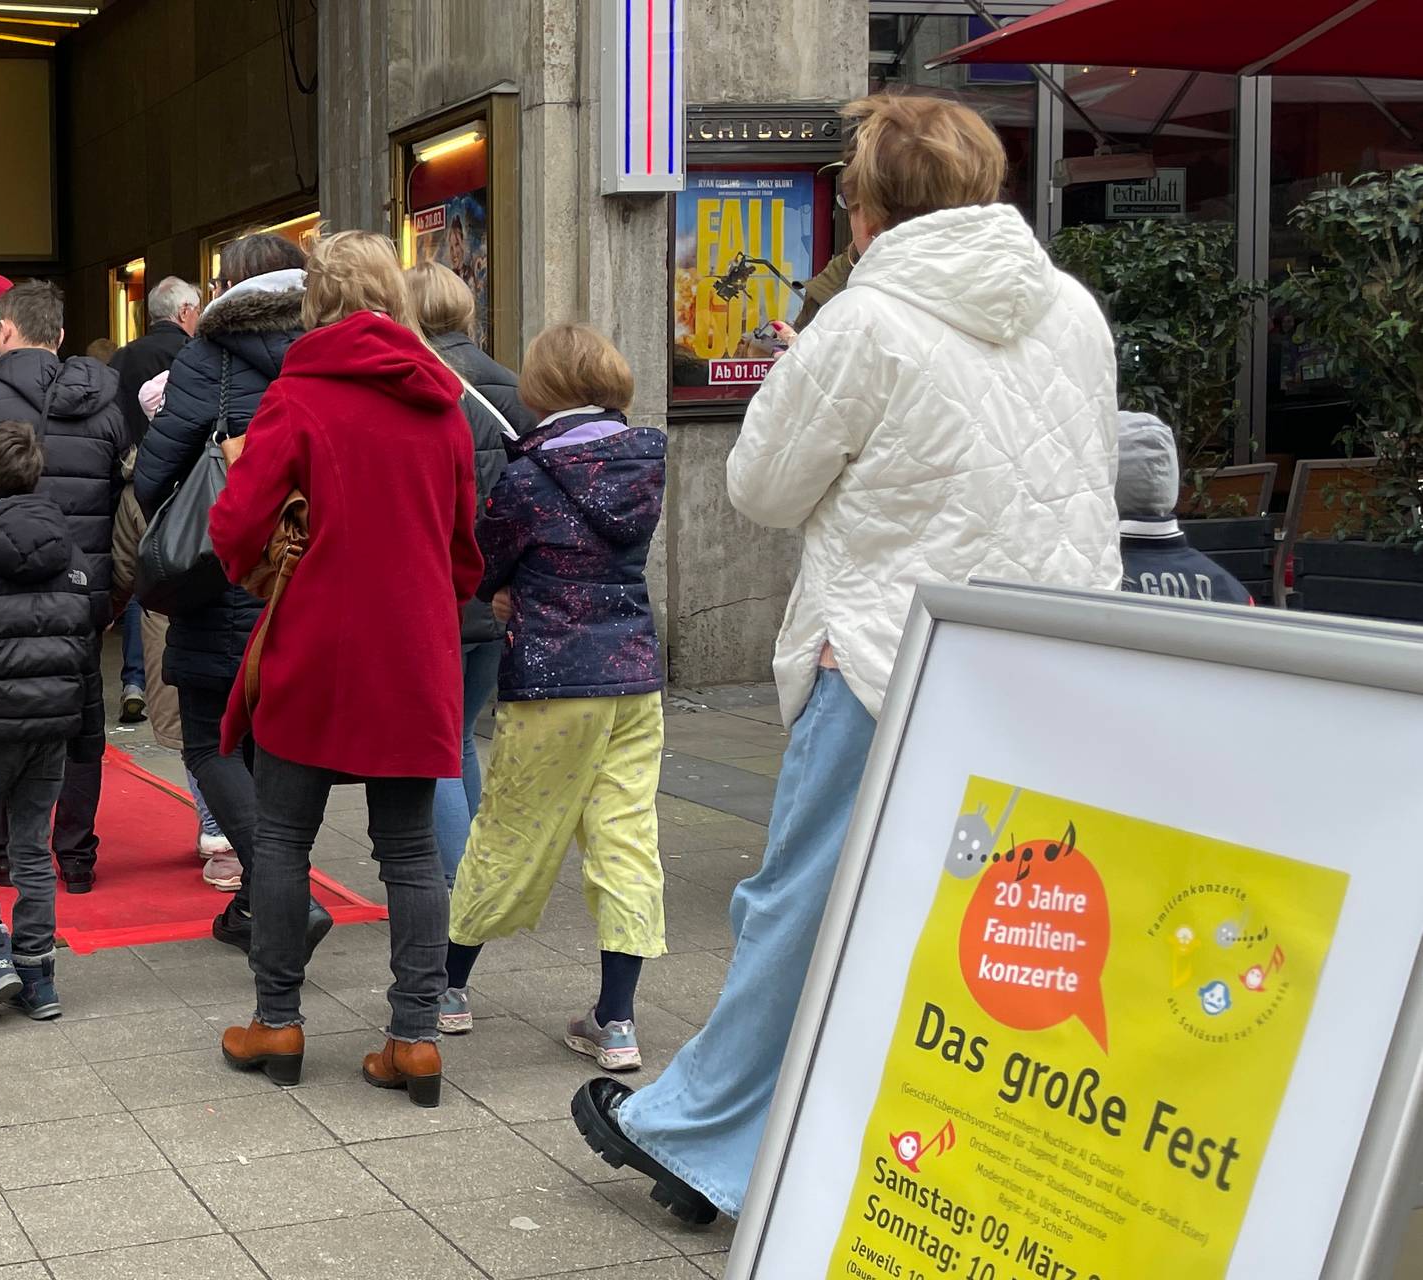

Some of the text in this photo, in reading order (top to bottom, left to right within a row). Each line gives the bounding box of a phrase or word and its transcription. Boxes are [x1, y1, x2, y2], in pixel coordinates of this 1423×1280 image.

[1113, 177, 1177, 201] extrablatt
[697, 198, 793, 277] FALL
[715, 365, 731, 379] Ab
[994, 881, 1087, 914] 20 Jahre
[1147, 883, 1247, 937] Familienkonzerte
[983, 918, 1087, 953] Familien-
[978, 954, 1079, 993] konzerte
[901, 1081, 1011, 1143] (Geschäftsbereichsvorstand
[914, 1001, 1241, 1192] Das große Fest
[863, 1193, 962, 1274] Sonntag:
[873, 1155, 1079, 1280] Samstag: 09. März
[1041, 1215, 1075, 1243] Schöne
[850, 1236, 903, 1279] Jeweils
